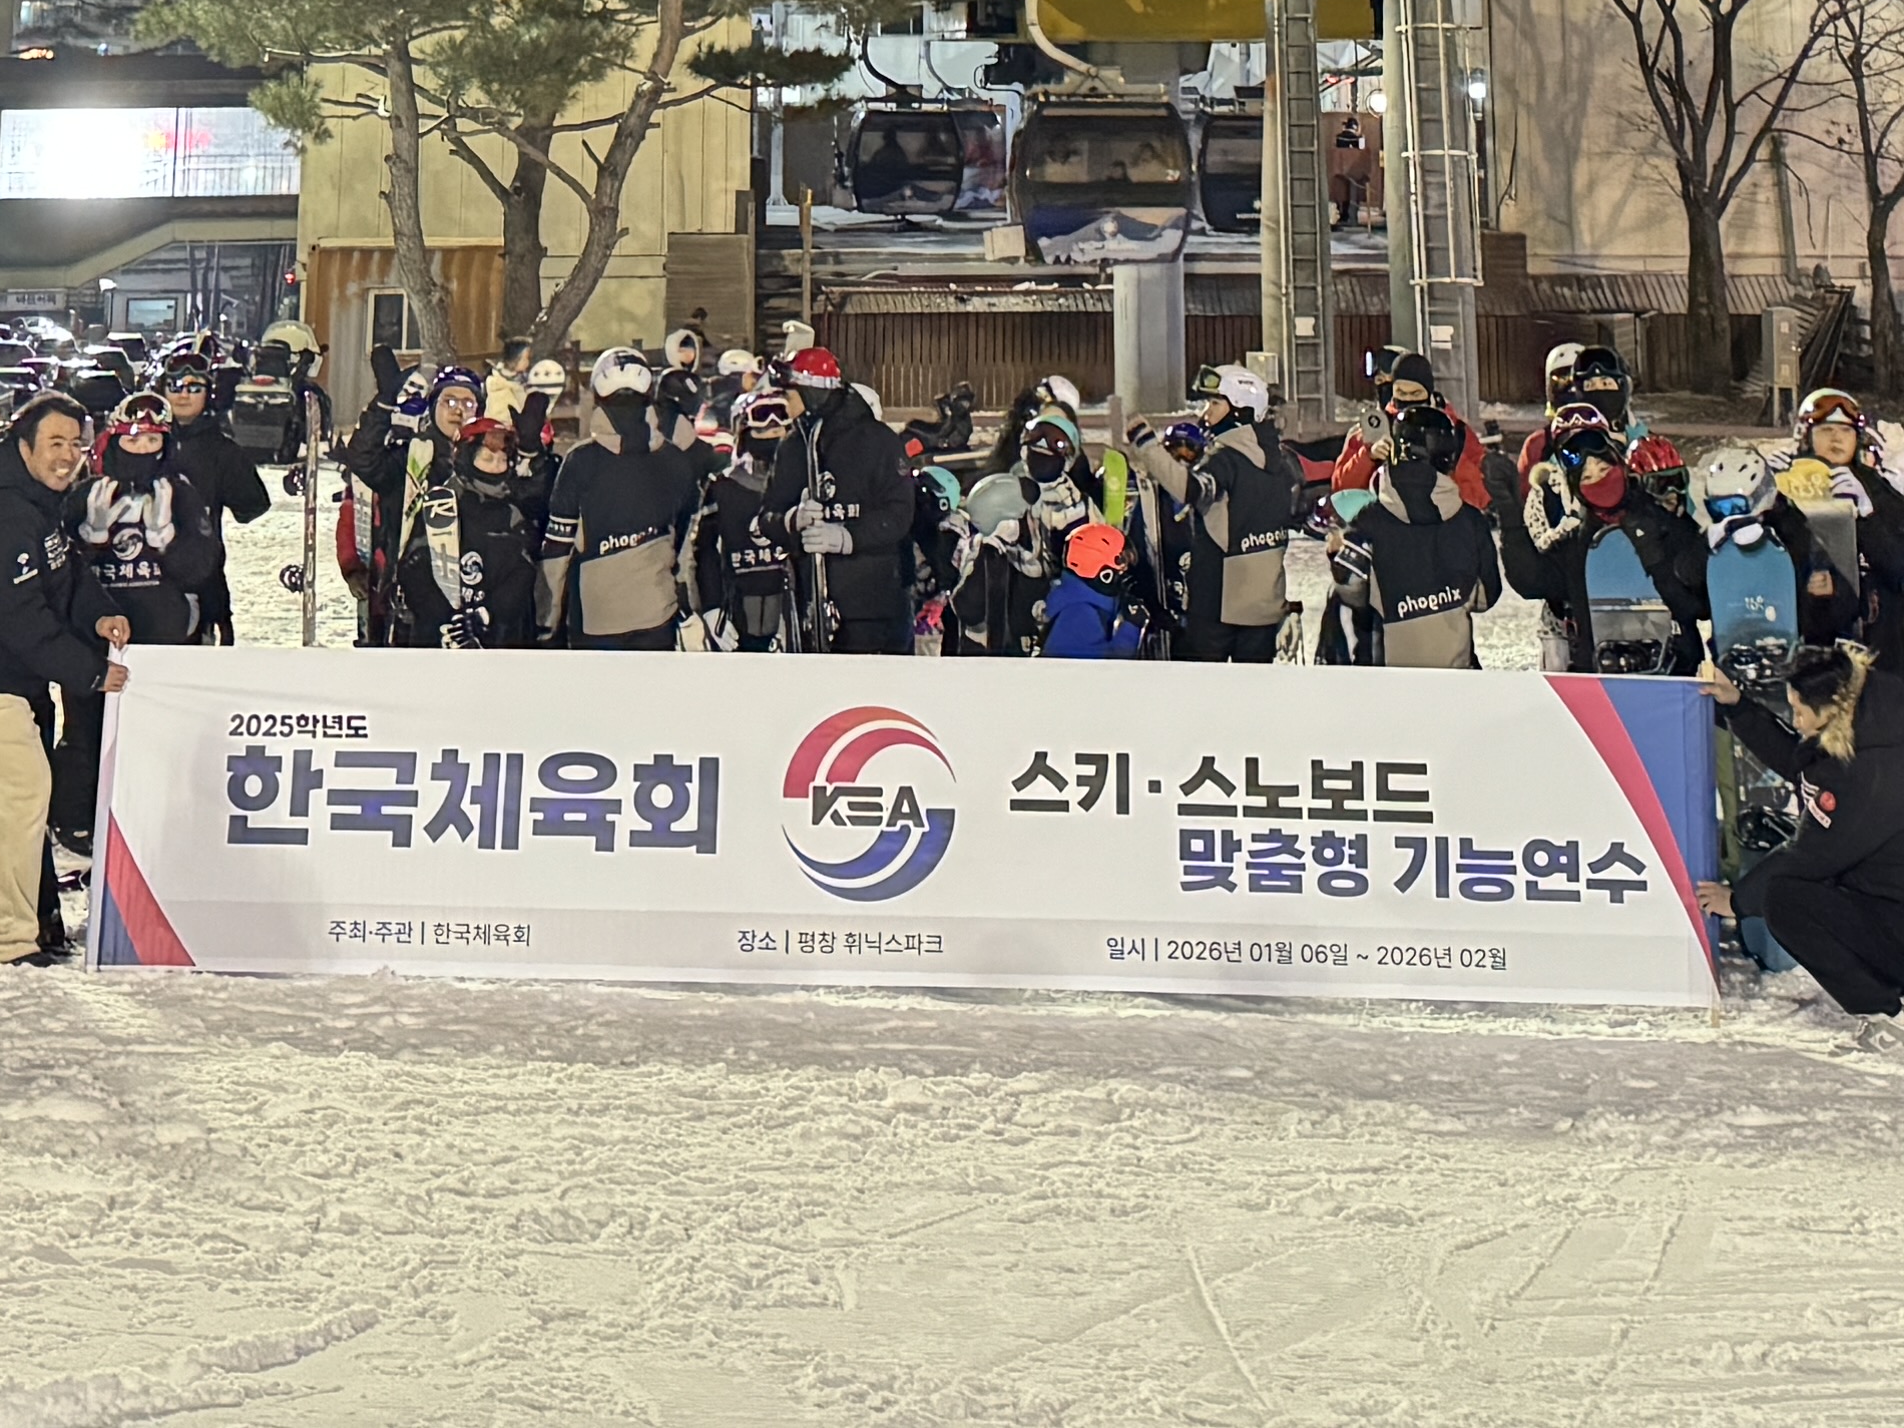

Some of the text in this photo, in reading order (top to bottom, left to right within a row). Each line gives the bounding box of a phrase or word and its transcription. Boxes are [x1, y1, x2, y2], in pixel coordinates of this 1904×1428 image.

[1398, 586, 1462, 618] phoenix
[229, 713, 369, 739] 2025학년도
[227, 745, 720, 855] 한국체육회
[1179, 828, 1649, 904] 맞춤형 기능연수
[328, 920, 413, 944] 주최·주관
[432, 921, 532, 947] 한국체육회
[737, 929, 778, 954] 장소
[797, 931, 837, 955] 평창
[843, 931, 944, 956] 휘닉스파크
[1106, 936, 1147, 961] 일시
[1166, 940, 1243, 964] 2026년
[1249, 941, 1294, 965] 01월
[1300, 943, 1349, 967] 06일
[1376, 945, 1453, 969] 2026년
[1460, 947, 1508, 972] 02월
